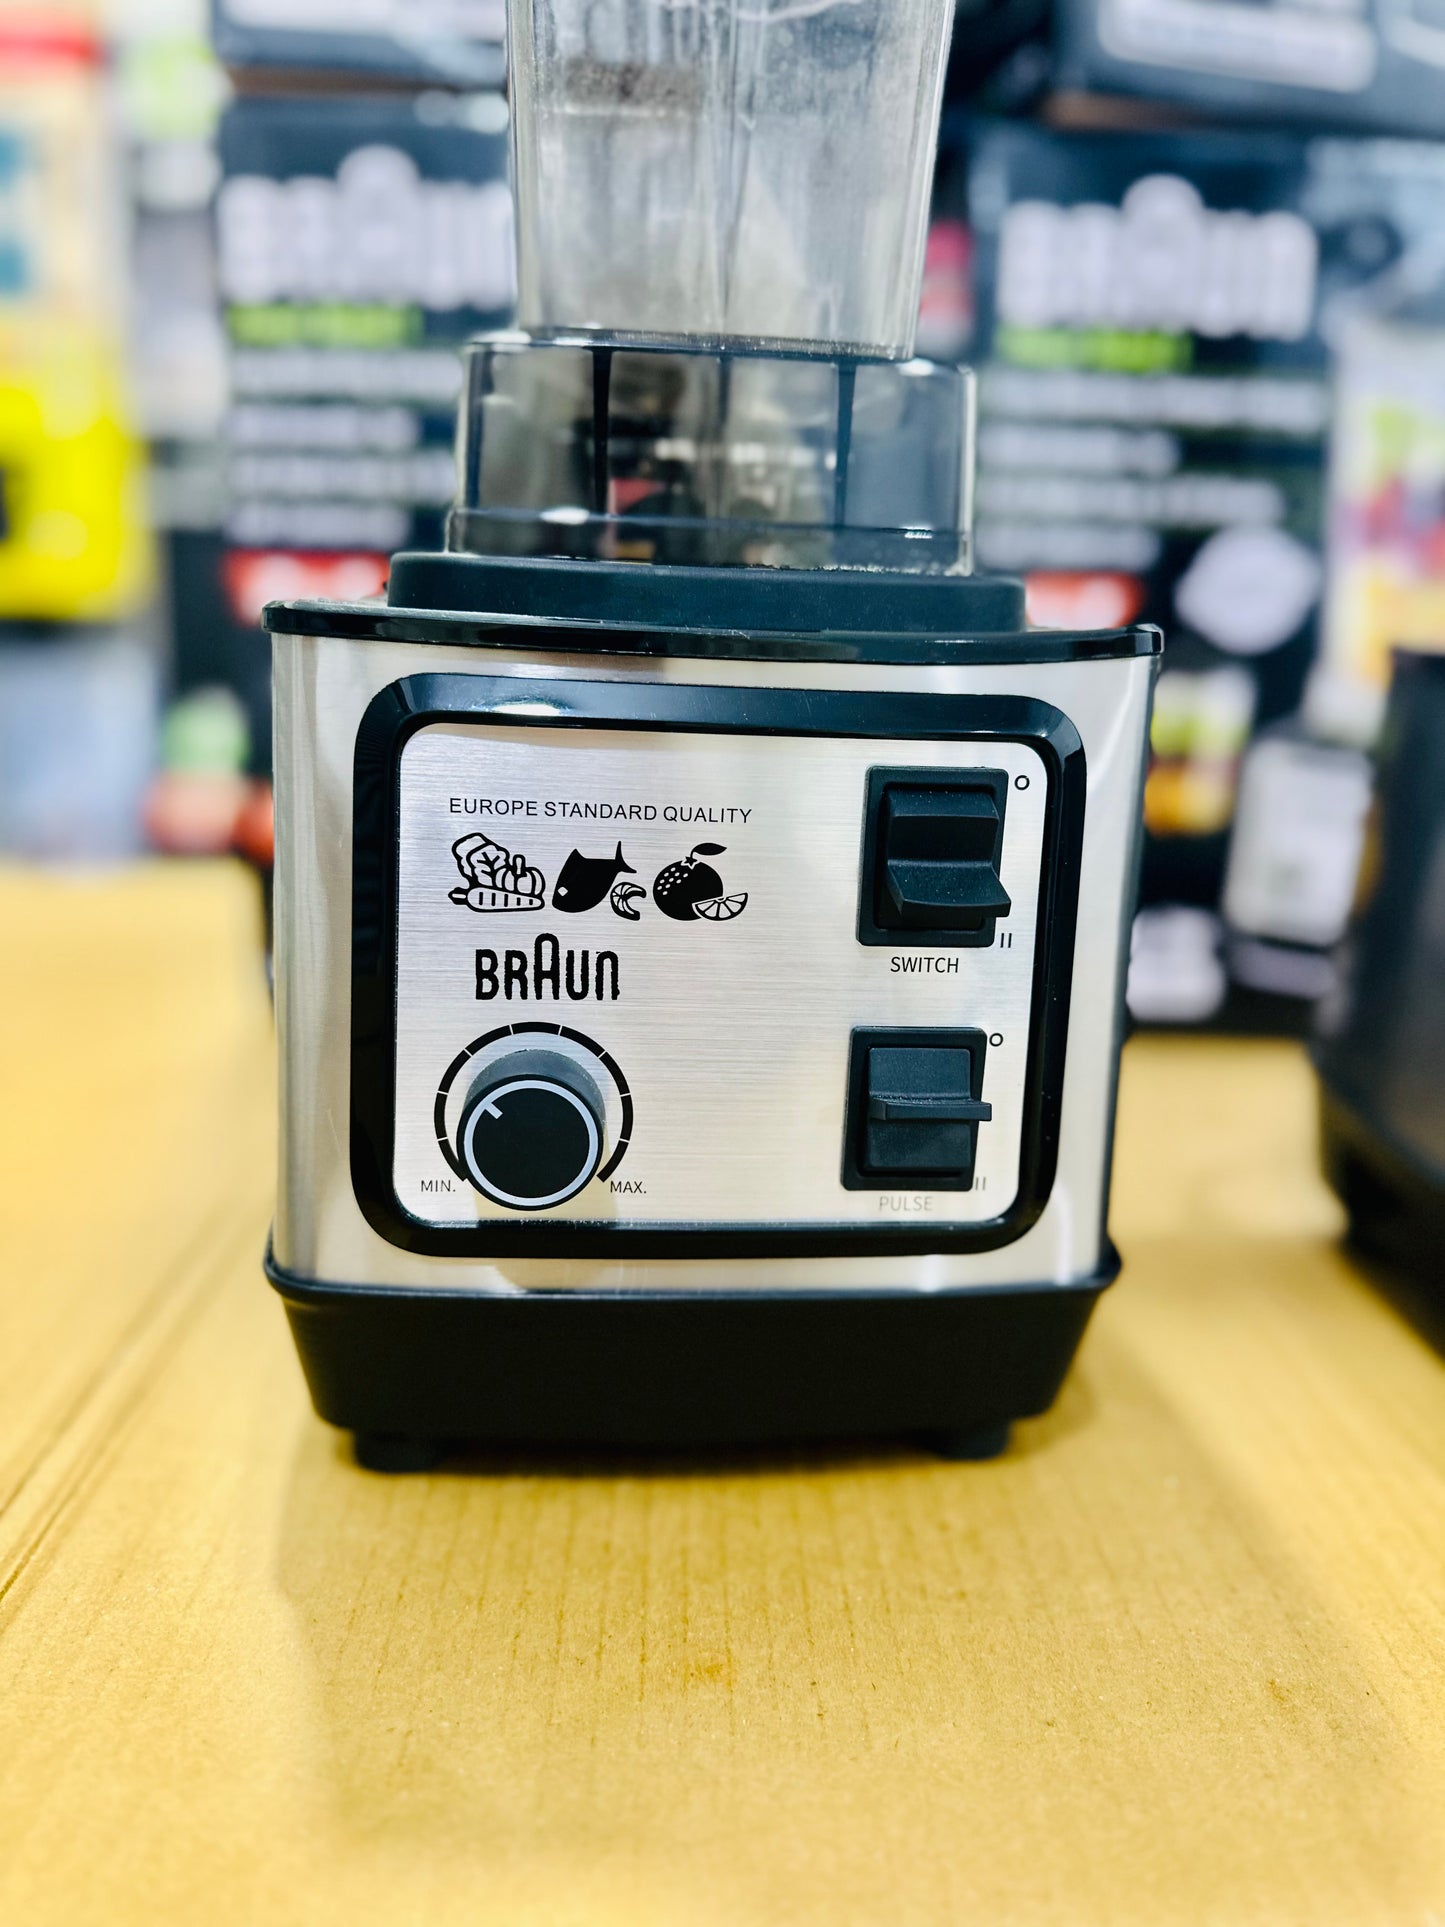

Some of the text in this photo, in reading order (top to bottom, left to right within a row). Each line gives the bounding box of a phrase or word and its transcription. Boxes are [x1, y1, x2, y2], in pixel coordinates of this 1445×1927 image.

[449, 797, 752, 824] EUROPE STANDARD QUALITY
[475, 932, 620, 1001] BRAUN
[890, 956, 960, 974] SWITCH
[420, 1179, 456, 1193] MIN.
[609, 1180, 648, 1195] MAX.
[879, 1195, 934, 1212] PULSE
